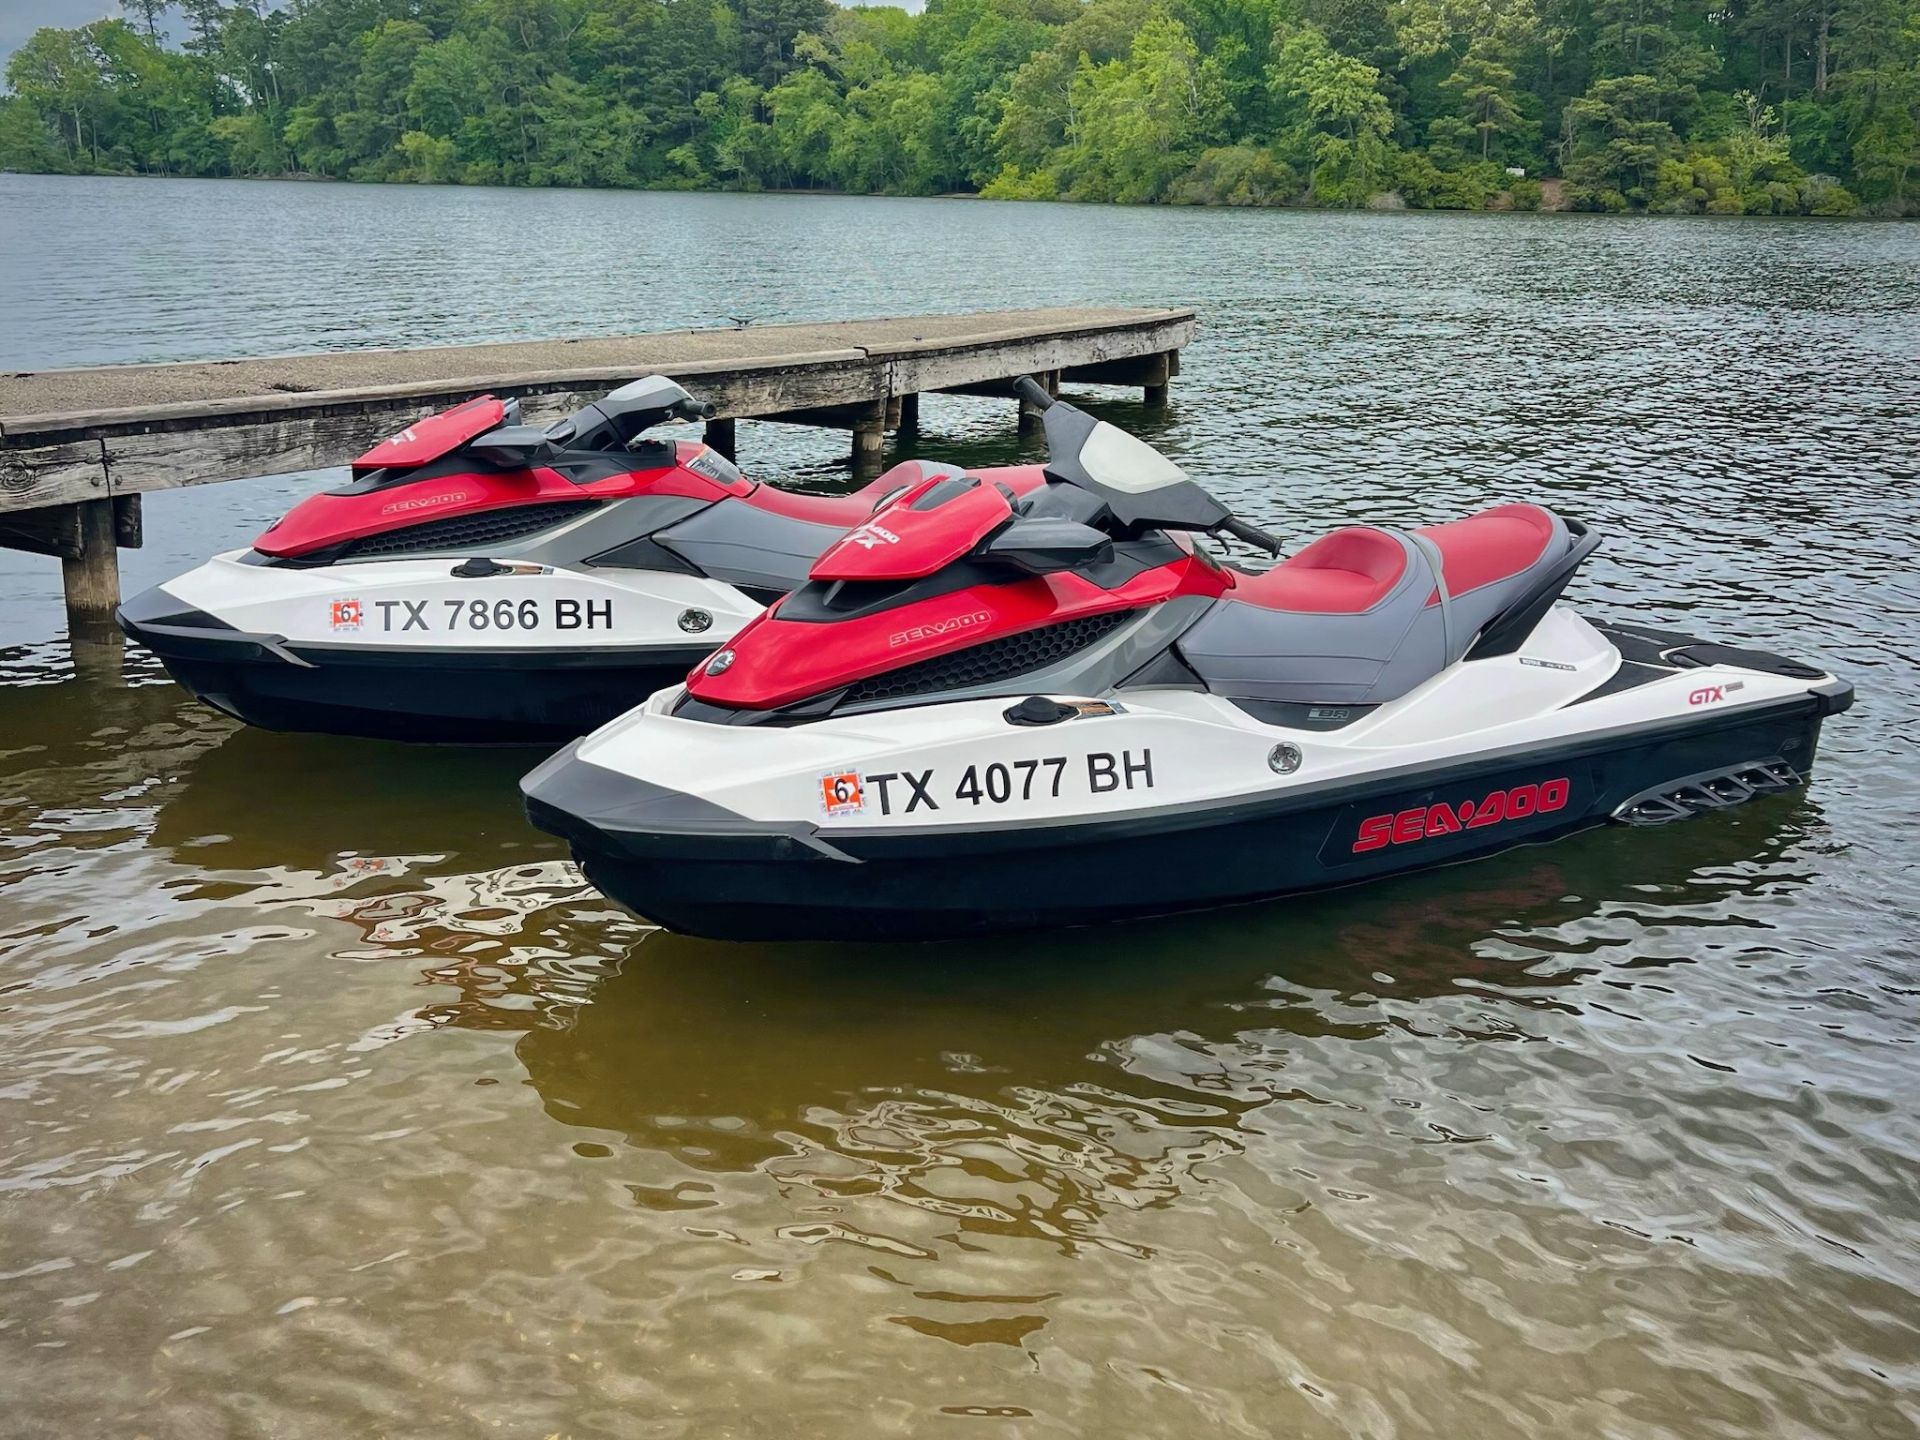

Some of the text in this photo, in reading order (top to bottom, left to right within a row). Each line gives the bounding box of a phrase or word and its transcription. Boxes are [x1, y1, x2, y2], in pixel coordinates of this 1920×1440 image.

[341, 604, 351, 622] 6
[375, 599, 613, 631] TX 7866 BH
[1689, 686, 1724, 705] GTX
[835, 778, 849, 803] 6
[866, 749, 1154, 815] TX 4077 BH
